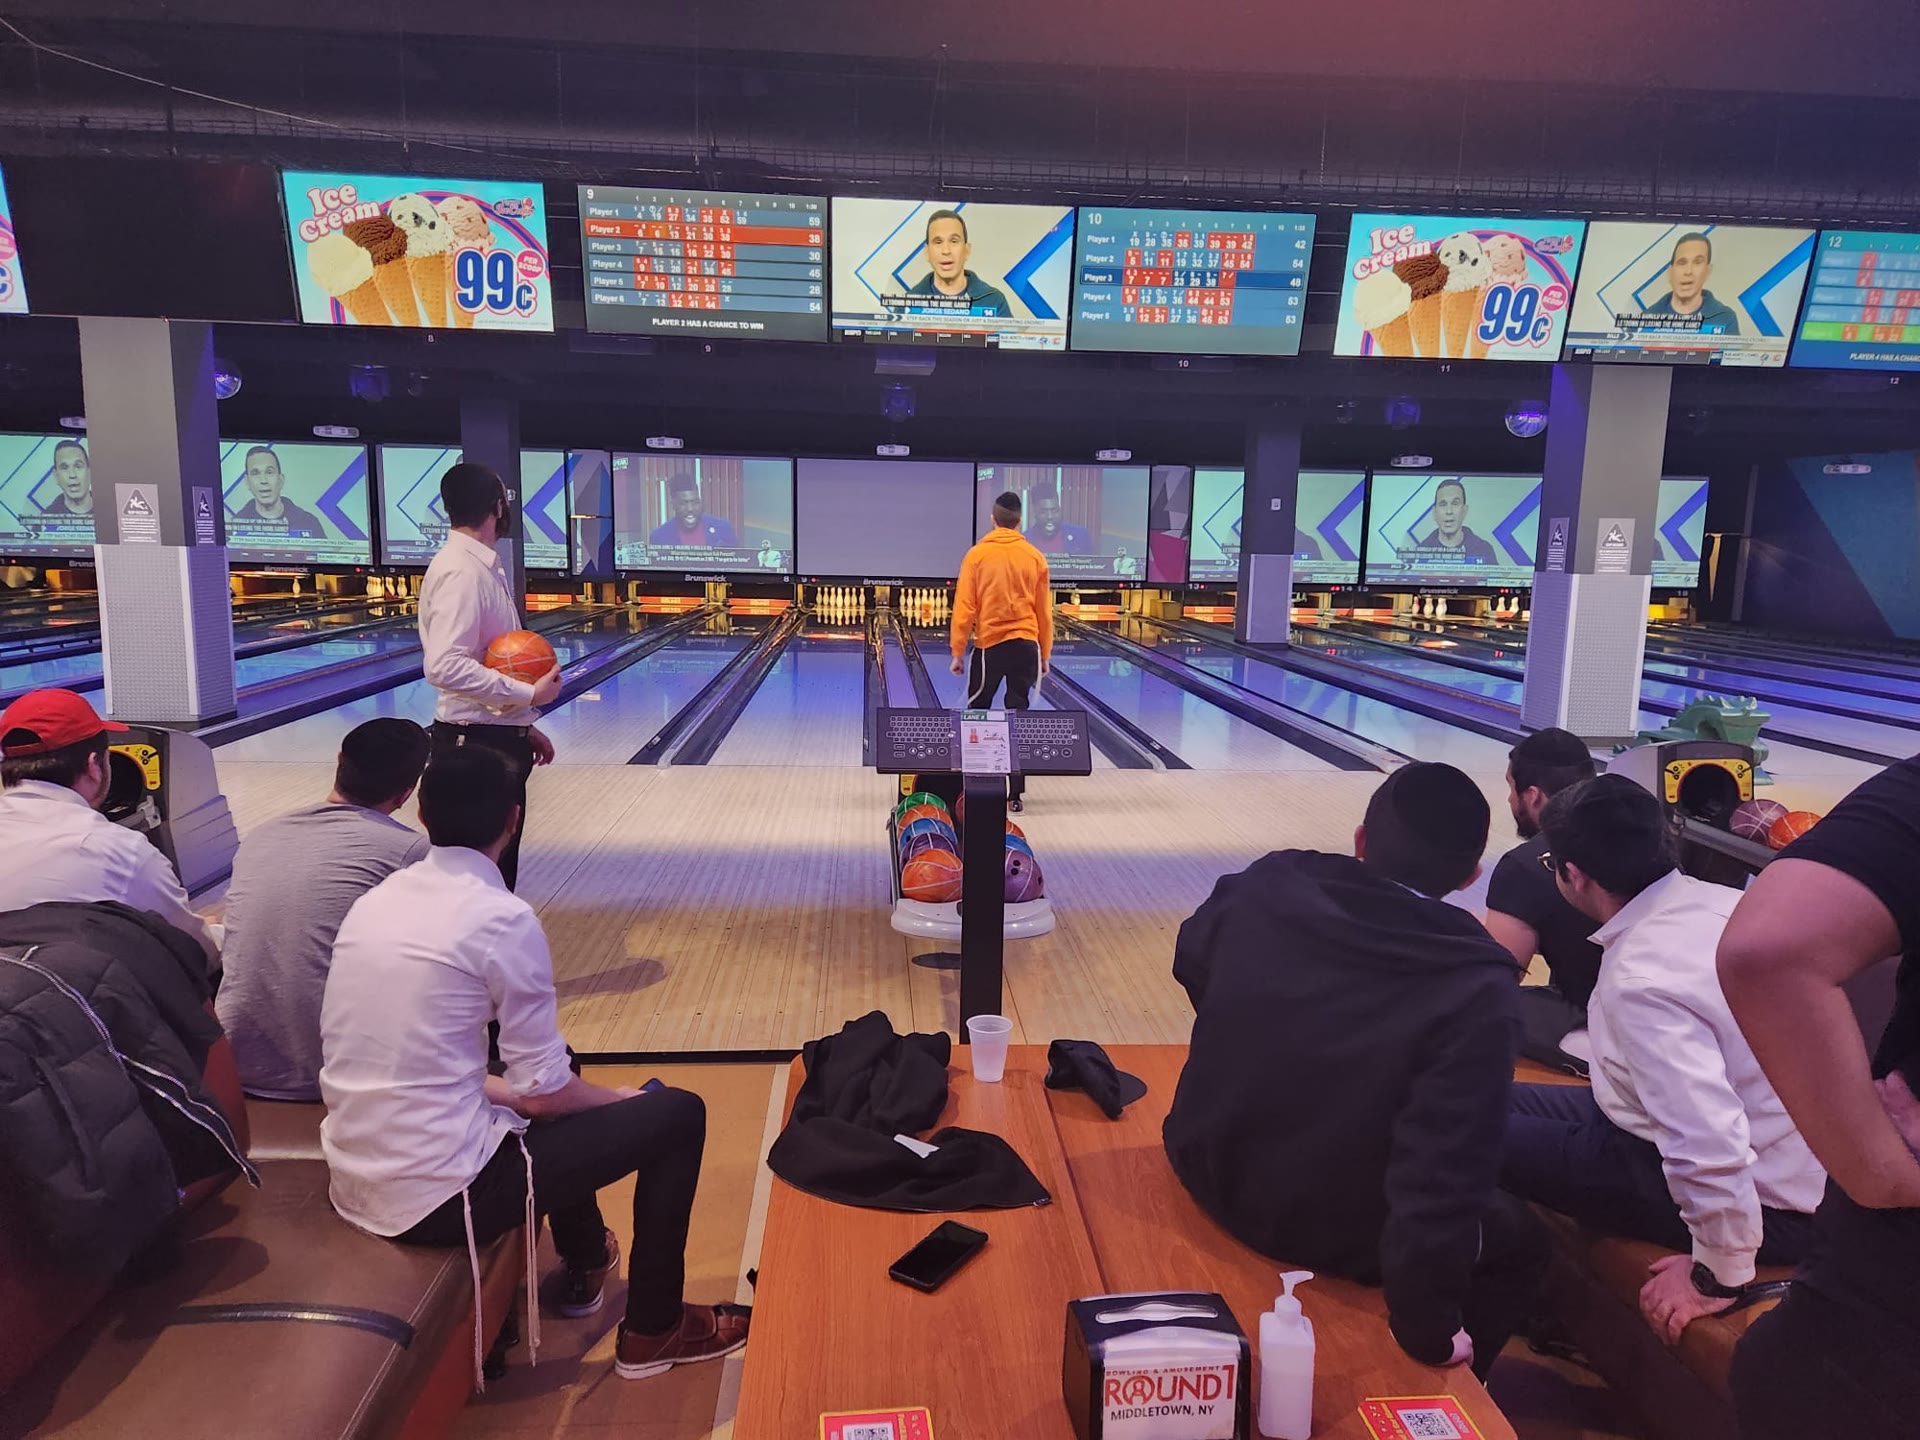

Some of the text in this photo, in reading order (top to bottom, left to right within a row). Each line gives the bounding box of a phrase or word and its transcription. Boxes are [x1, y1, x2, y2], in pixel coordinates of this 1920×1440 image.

[307, 184, 357, 217] Ice
[586, 189, 594, 200] 9
[300, 201, 381, 243] cream
[590, 207, 613, 216] Player
[809, 217, 820, 226] 59
[1088, 213, 1102, 224] 10
[590, 225, 612, 234] Player
[808, 234, 820, 244] 38
[1370, 224, 1414, 255] Ice
[1087, 235, 1109, 244] Player
[1295, 240, 1306, 249] 42
[1829, 236, 1843, 248] 12
[592, 242, 613, 252] Player
[809, 252, 820, 260] 30
[524, 256, 538, 264] PER
[1086, 254, 1108, 264] Player
[1144, 258, 1153, 266] 11
[1160, 258, 1170, 266] 11
[1292, 260, 1304, 268] 54
[1353, 240, 1431, 280] cream
[518, 262, 542, 273] SCOOP
[592, 260, 614, 268] Player
[809, 269, 820, 278] 45
[594, 276, 615, 286] Player
[809, 286, 820, 294] 28
[1084, 274, 1106, 283] Player
[1128, 276, 1134, 284] 7
[1144, 276, 1150, 284] 7
[1160, 277, 1166, 285] 7
[1174, 278, 1184, 286] 23
[1190, 278, 1200, 286] 29
[1206, 278, 1216, 287] 38
[1290, 278, 1302, 287] 48
[595, 294, 617, 303] Player
[810, 303, 820, 312] 54
[1084, 293, 1105, 302] Player
[1126, 295, 1132, 304] 9
[1141, 296, 1150, 304] 13
[1188, 296, 1198, 305] 44
[1204, 298, 1214, 306] 44
[1288, 296, 1298, 306] 53
[652, 318, 680, 326] PLAYER
[709, 321, 738, 329] CHANCE
[1082, 312, 1104, 320] Player
[1140, 314, 1150, 322] 12
[1155, 315, 1164, 323] 21
[1286, 316, 1296, 324] 53
[1850, 352, 1875, 360] PLAYER
[684, 574, 727, 582] Brunswick
[1163, 1365, 1220, 1374] AMUSEMENT
[1110, 1404, 1215, 1421] MIDDLETOWN, NY
